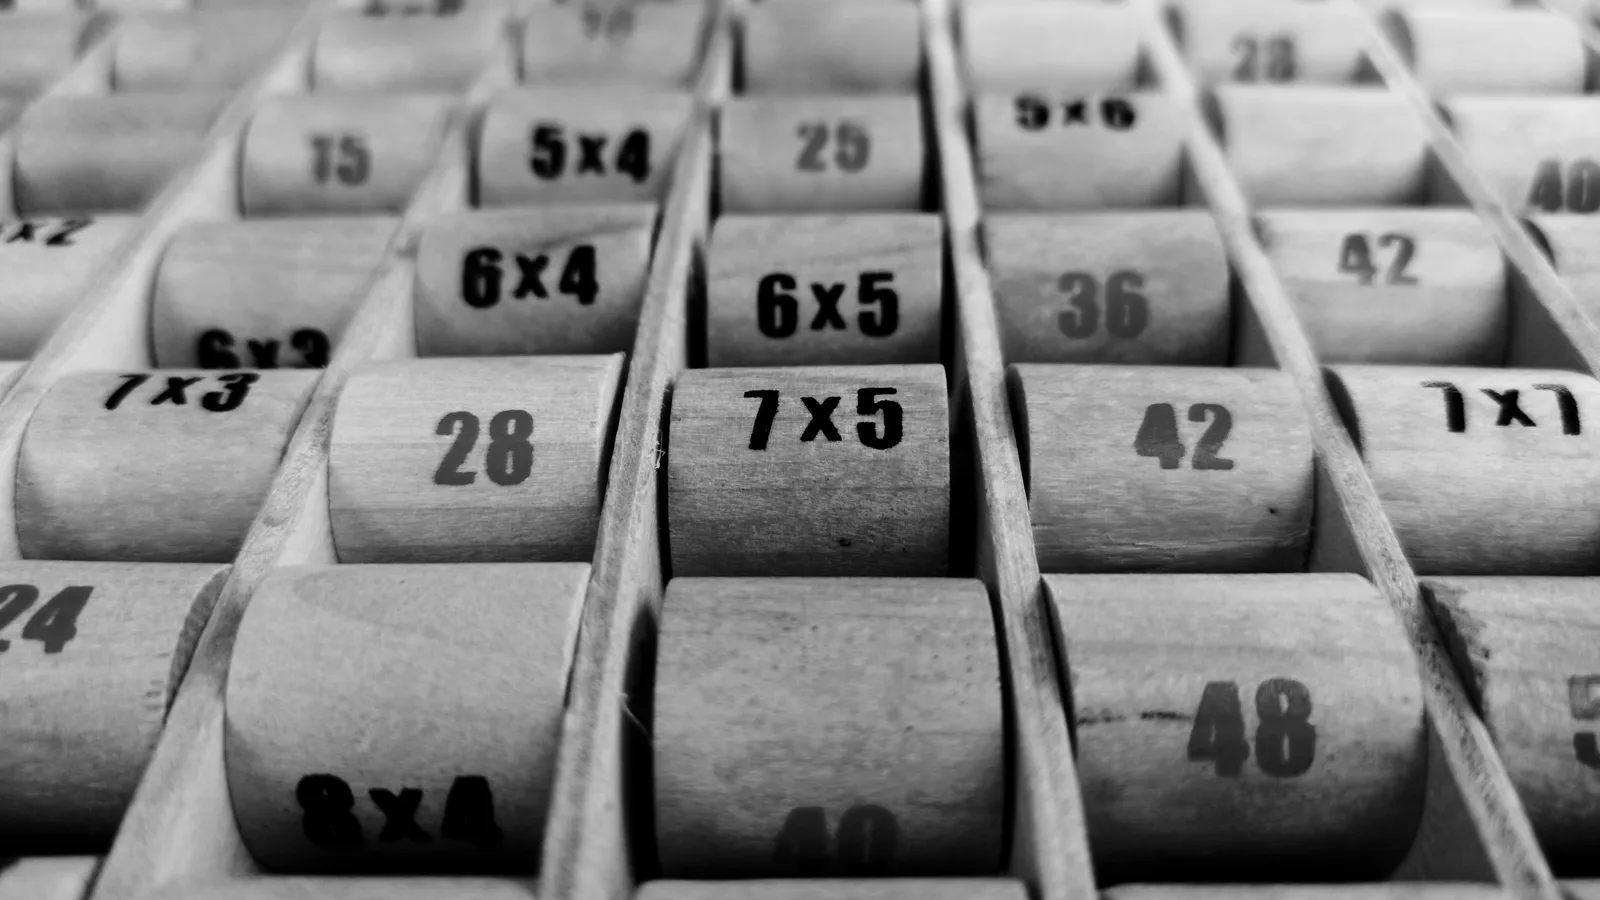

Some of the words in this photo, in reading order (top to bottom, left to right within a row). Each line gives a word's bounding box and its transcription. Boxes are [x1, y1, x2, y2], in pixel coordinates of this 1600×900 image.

[311, 133, 371, 187] 15
[529, 123, 651, 184] 5x4
[795, 122, 871, 173] 25
[1527, 158, 1600, 213] 40
[0, 217, 95, 246] x2
[1338, 233, 1419, 286] 42
[462, 245, 598, 308] 6x4
[757, 271, 900, 339] 6x5
[1057, 271, 1149, 340] 36
[104, 372, 260, 412] 7x3
[743, 387, 903, 450] 7x5
[434, 409, 535, 486] 28
[1134, 403, 1234, 470] 42
[1187, 677, 1316, 778] 48
[295, 773, 503, 848] 8x4
[773, 805, 900, 876] 40
